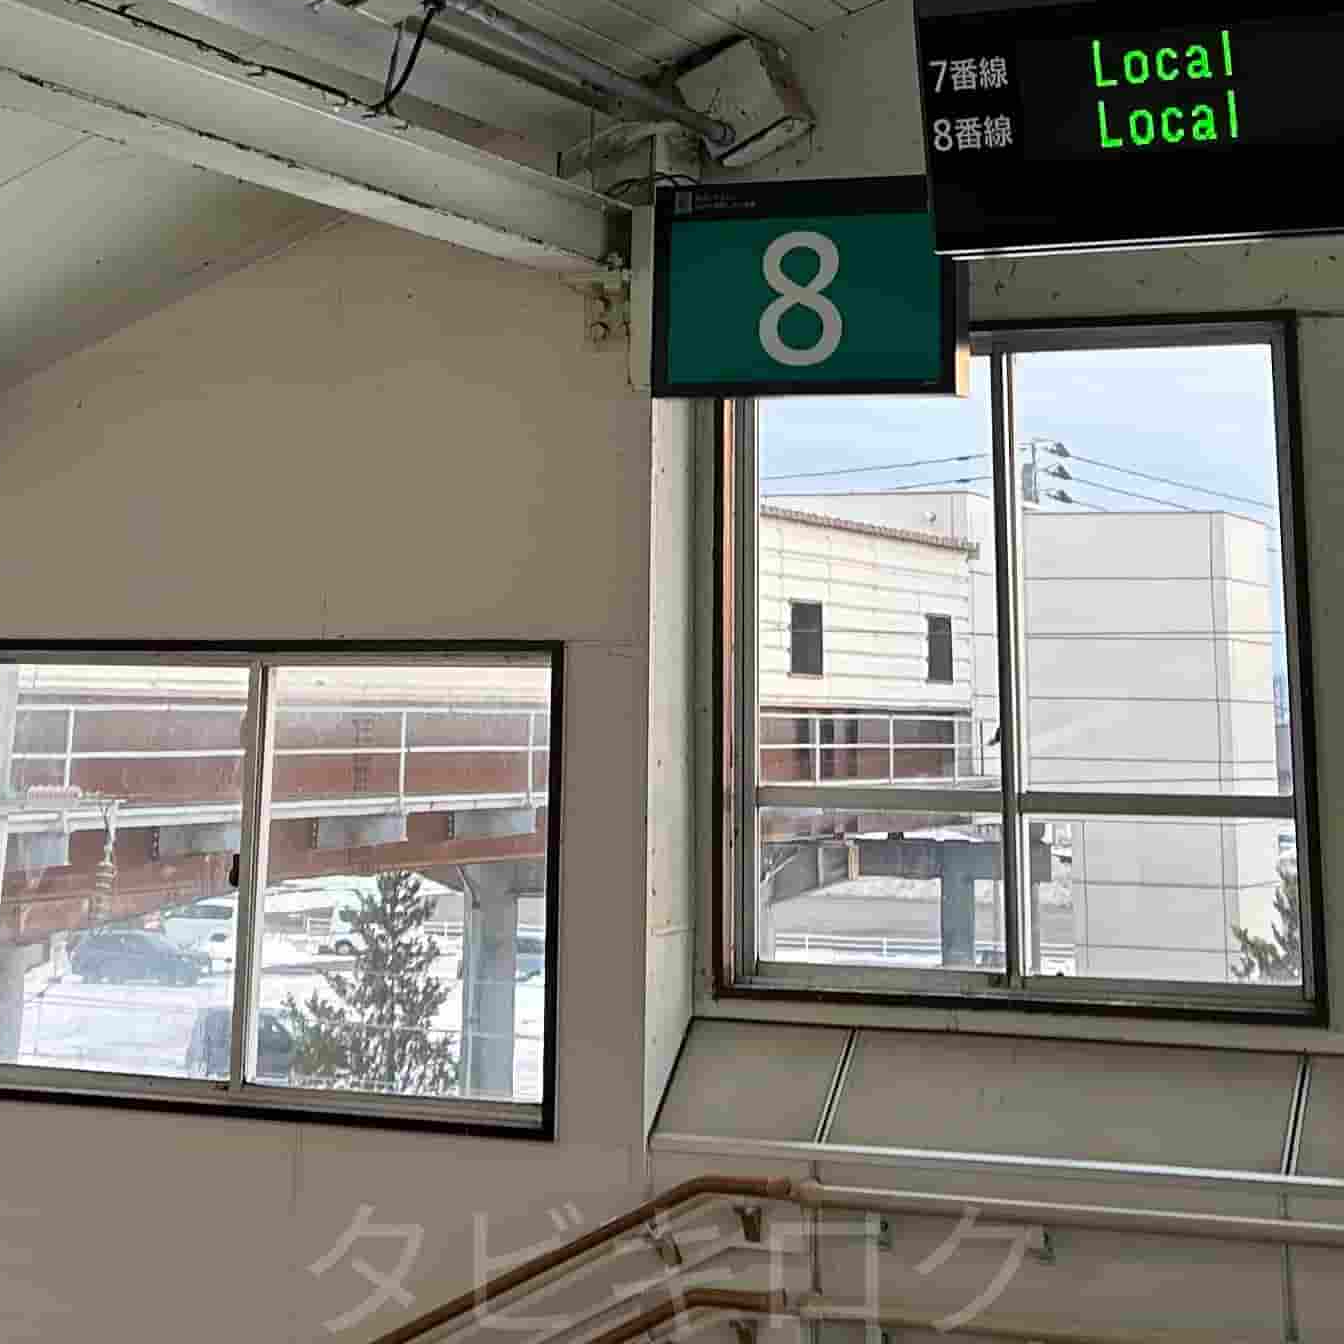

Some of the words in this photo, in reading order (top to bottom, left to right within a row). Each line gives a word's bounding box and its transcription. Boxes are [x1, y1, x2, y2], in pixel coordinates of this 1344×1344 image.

[928, 56, 1008, 93] 7番線
[1092, 30, 1233, 87] Local
[933, 114, 1013, 152] 8番線
[1098, 89, 1239, 148] Local
[759, 231, 843, 366] 8
